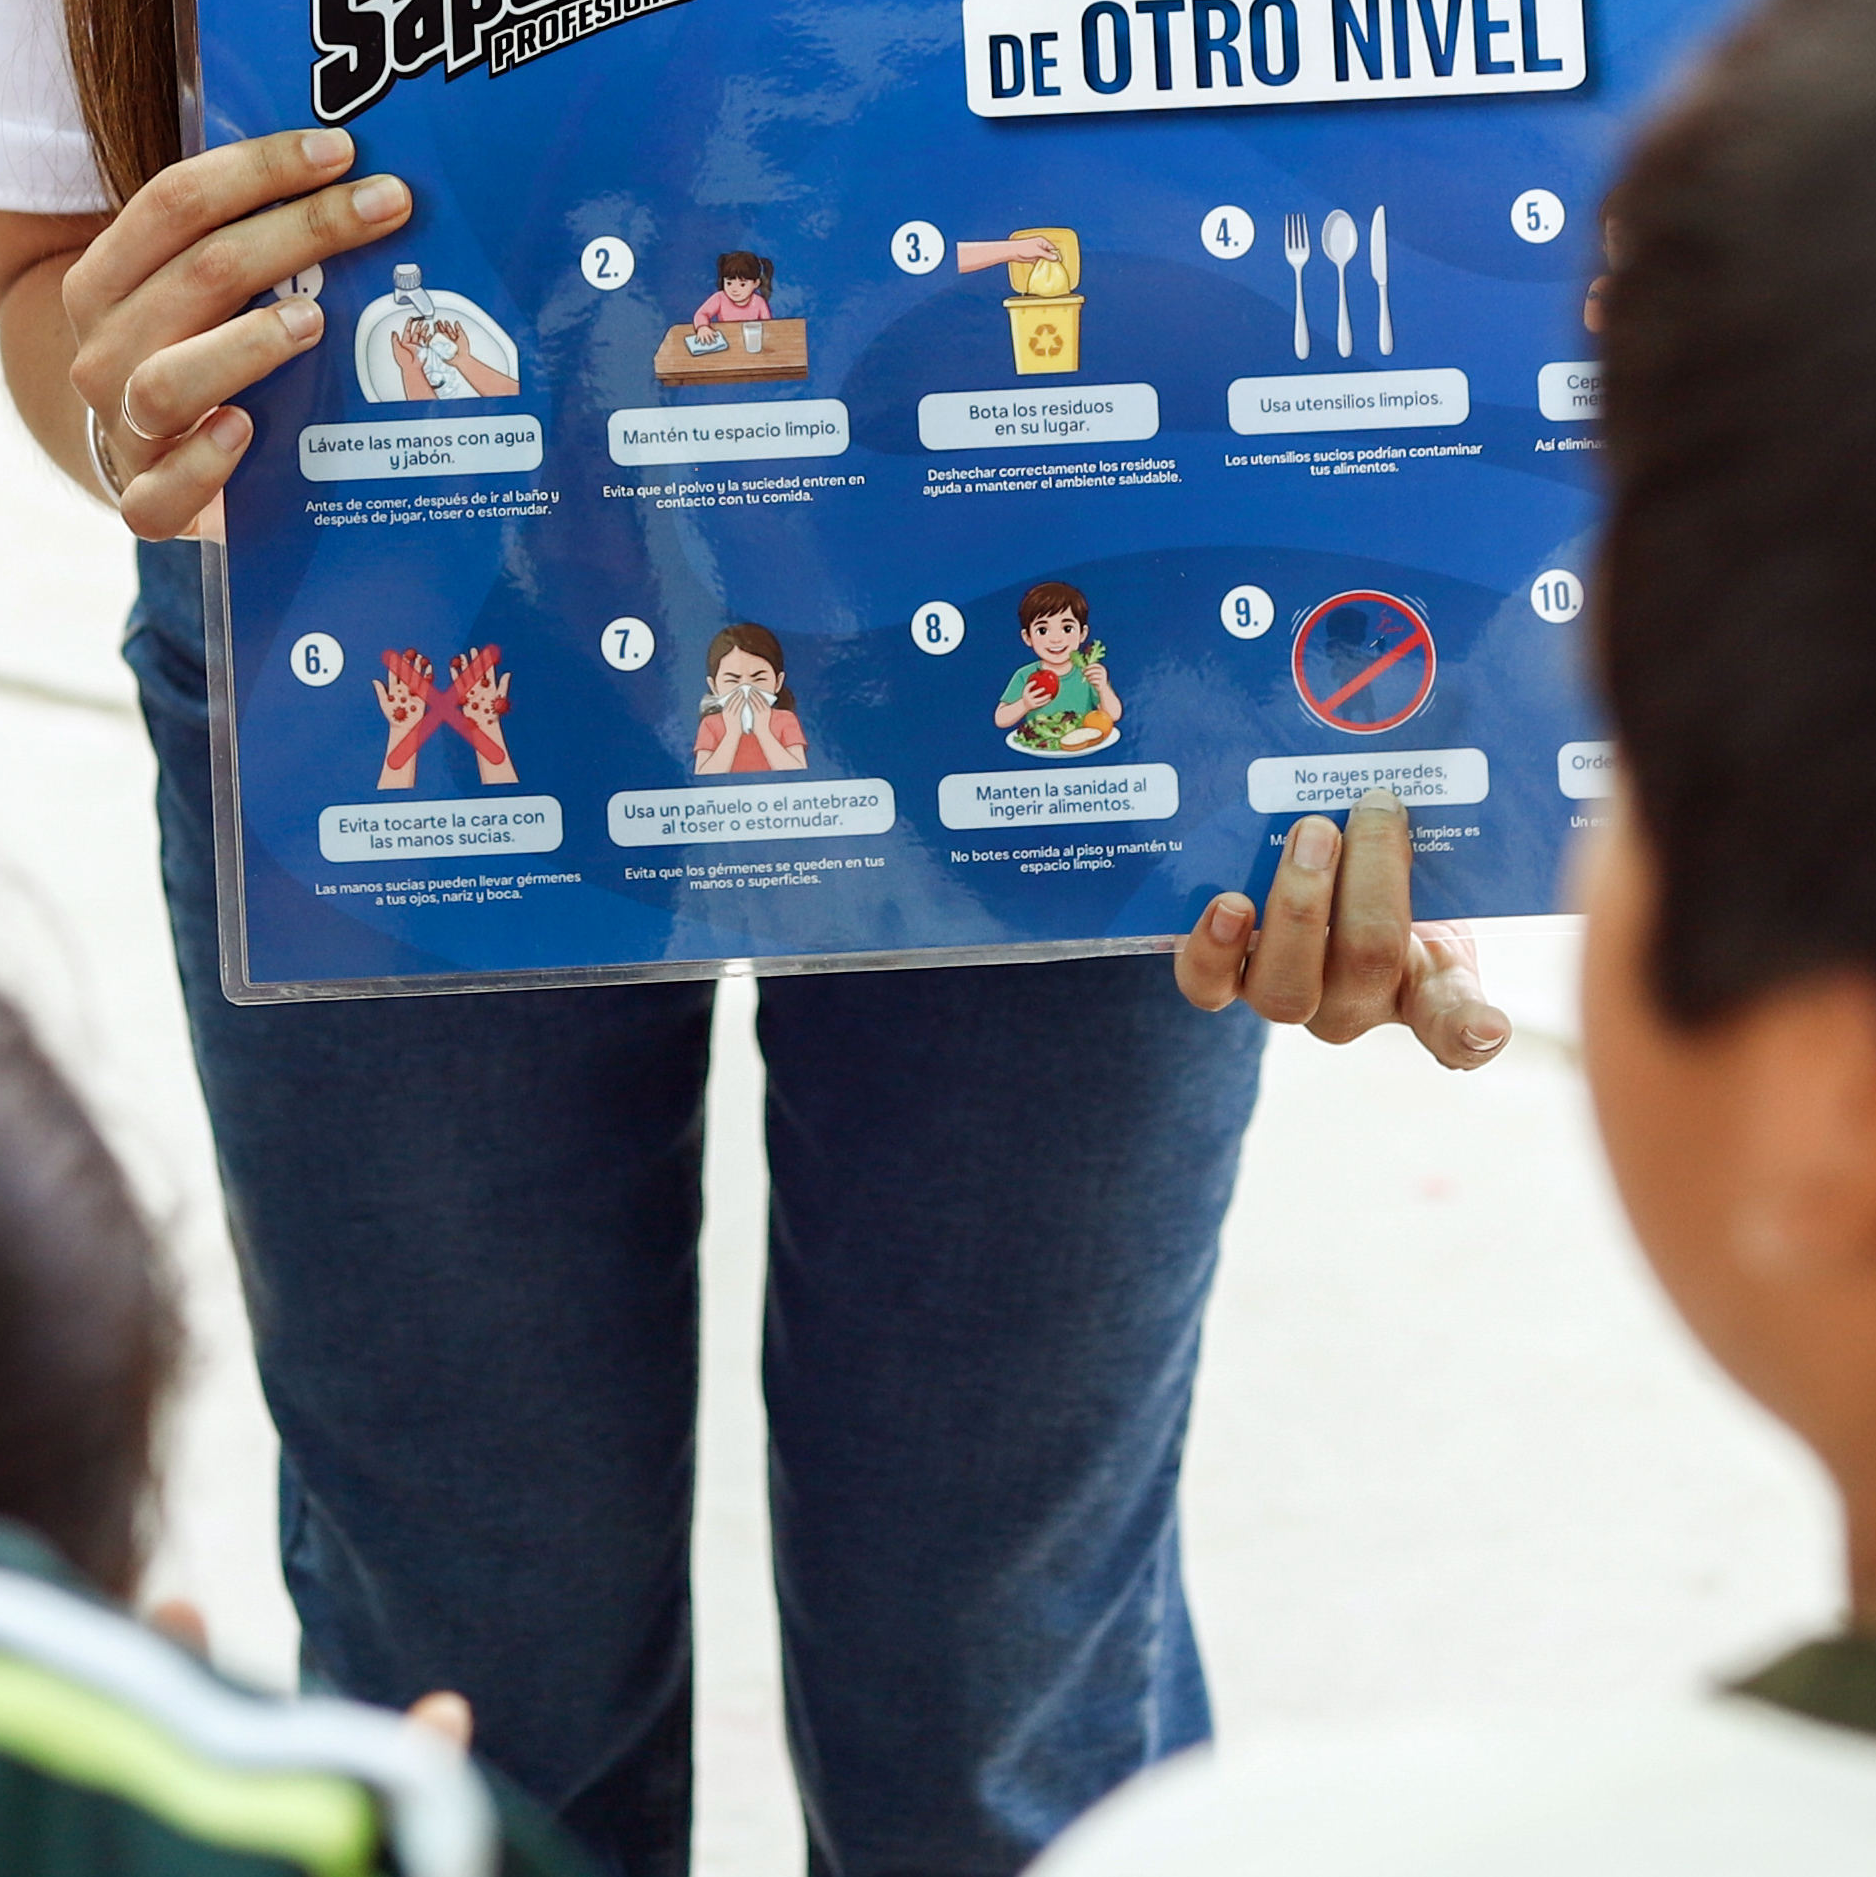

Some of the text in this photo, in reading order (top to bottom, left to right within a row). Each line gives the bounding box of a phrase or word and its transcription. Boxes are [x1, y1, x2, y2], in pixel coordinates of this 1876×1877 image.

[989, 32, 1061, 99] DE
[1526, 201, 1549, 231] 5.
[1216, 218, 1239, 247] 4.
[905, 233, 929, 263] 3.
[595, 248, 619, 279] 2.
[969, 400, 1113, 420] Bota los residuos
[1260, 391, 1442, 413] Usa utensilios limpios.
[623, 421, 840, 445] Mantén tu espacio limpio.
[995, 420, 1090, 436] en su lugar.
[308, 431, 535, 453] Lávate las manos con agua
[1534, 439, 1555, 452] Así
[390, 450, 454, 469] y jabón.
[1225, 443, 1482, 467] Los utensilios sucios podrían contaminar
[928, 458, 1176, 481] Deshechar correctamente los residuos
[1310, 461, 1399, 476] tus alimentos.
[603, 475, 865, 499] Evita que el polvo y la suciedad entren en
[923, 471, 1182, 497] ayuda a mantener el ambiente saludable.
[305, 489, 559, 513] Antes de comer, después de ir al baño y
[656, 490, 813, 509] contacto con tu comida.
[314, 504, 552, 527] después de jugar, toser o estornudar.
[1537, 581, 1577, 612] 10.
[1235, 598, 1258, 627] 9.
[925, 613, 949, 643] 8.
[614, 630, 638, 659] 7.
[305, 644, 328, 674] 6.
[1295, 765, 1447, 785] No rayes paredes,
[976, 778, 1147, 801] Manten la sanidad al
[1392, 780, 1448, 796] baños.
[624, 794, 878, 819] Usa un pañuelo o el antebrazo
[990, 797, 1134, 820] ingerir alimentos.
[339, 812, 544, 833] Evita tocarte la cara con
[662, 812, 843, 834] al toser o estornudar.
[1417, 826, 1461, 841] limpios
[1464, 826, 1480, 836] es
[1571, 816, 1587, 828] Un
[370, 831, 515, 849] las manos sucias.
[951, 839, 1182, 863] No botes comida al piso y mantén tu
[1413, 839, 1454, 853] todos.
[625, 857, 885, 880] Evita que los gérmenes se queden en tus
[1020, 857, 1115, 874] espacio limpio.
[315, 873, 581, 895] Las manos sucias pueden llevar gérmenes
[690, 874, 821, 890] manos o superficies.
[375, 888, 522, 905] a tus ojos, nariz y boca.
